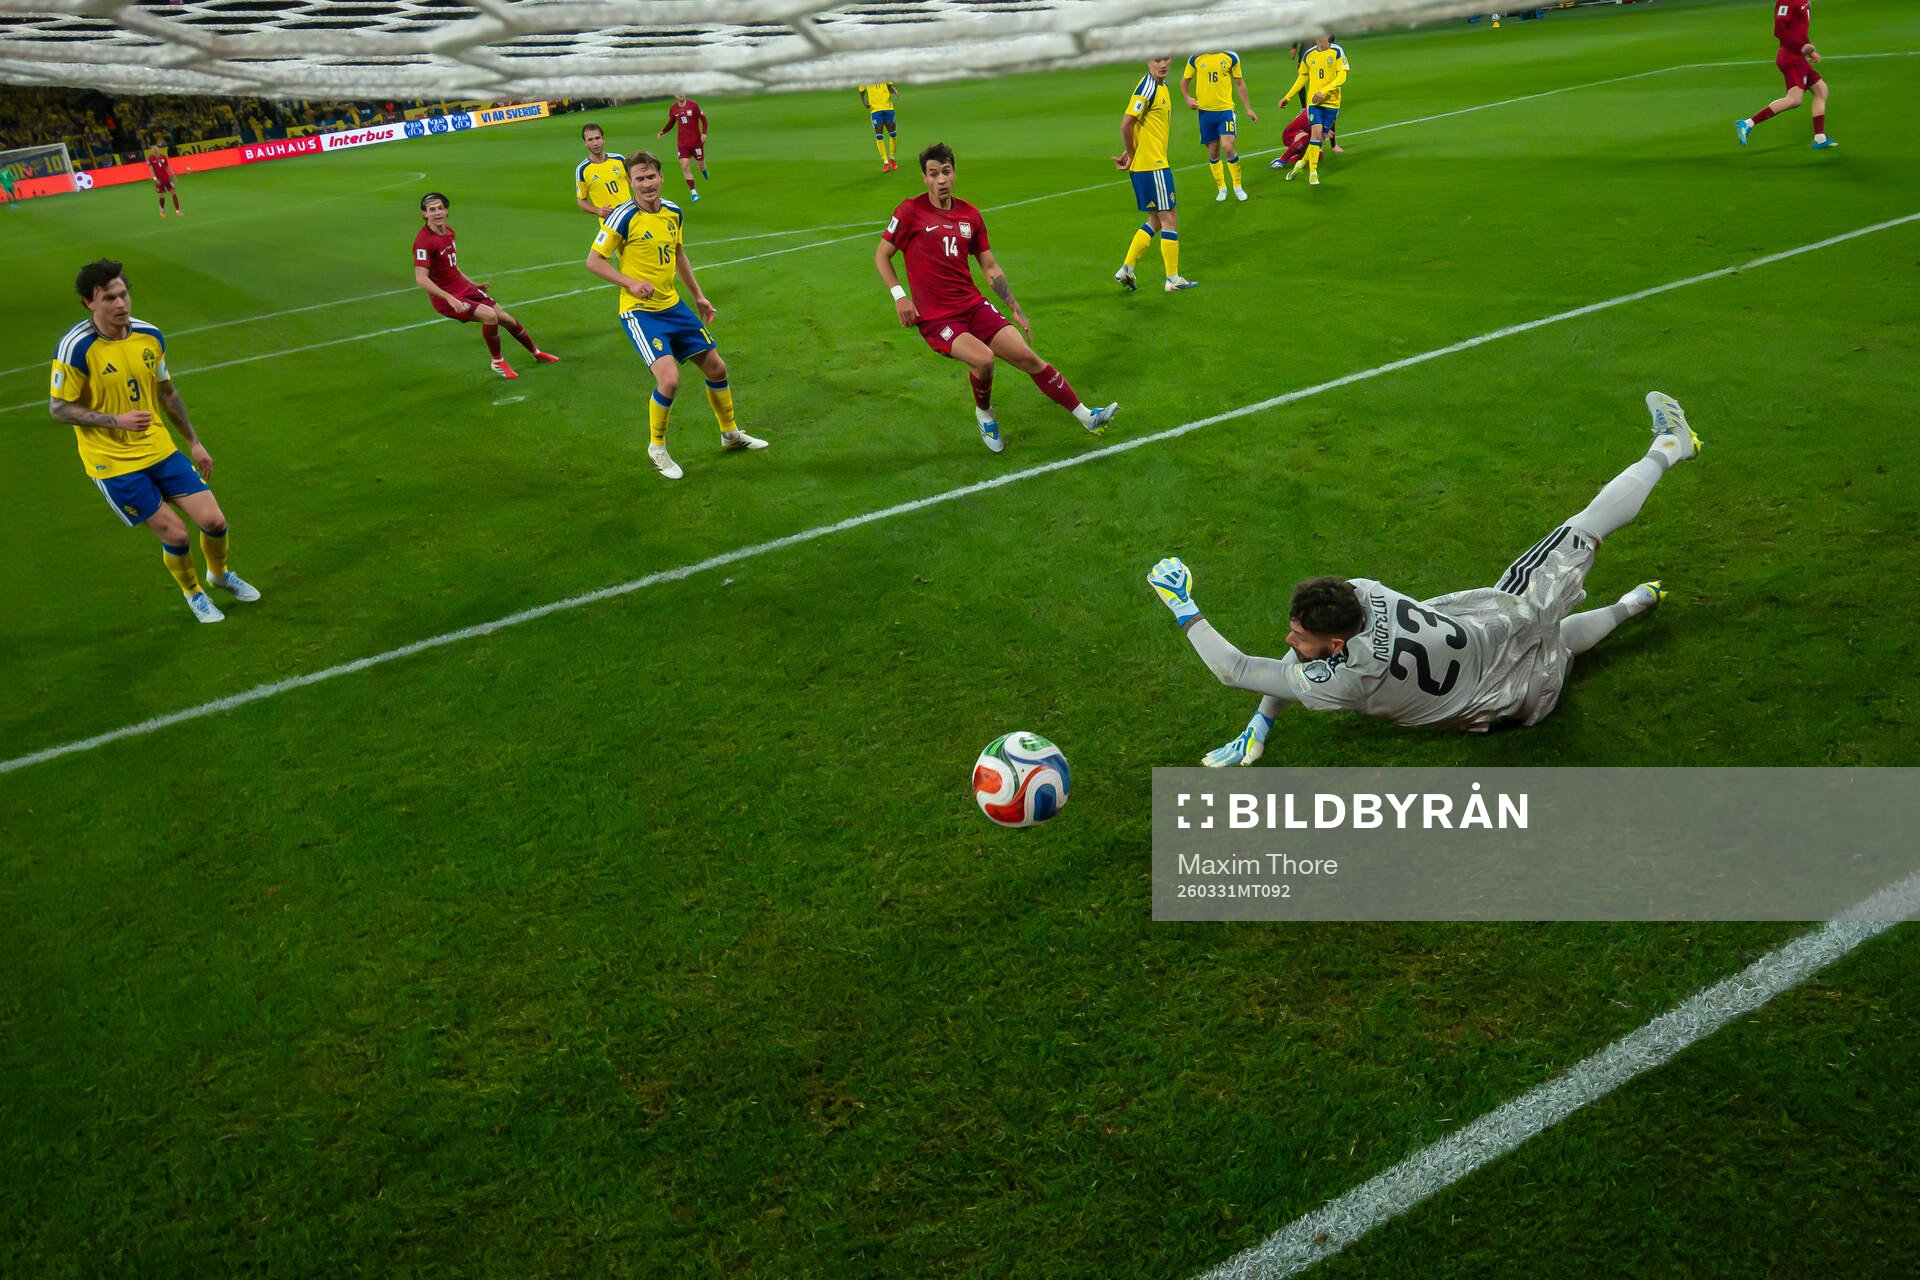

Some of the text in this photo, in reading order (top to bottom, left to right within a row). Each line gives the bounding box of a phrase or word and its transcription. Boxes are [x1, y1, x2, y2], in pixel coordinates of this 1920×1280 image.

[1208, 71, 1218, 83] 16
[481, 111, 492, 123] VI
[505, 104, 542, 119] SVERIGE
[1225, 121, 1235, 132] 16
[328, 128, 394, 147] Interbus
[245, 138, 317, 160] BAUHAUS
[604, 180, 619, 195] 10
[657, 244, 671, 266] 15
[942, 235, 959, 257] 14
[127, 378, 141, 402] 3
[1389, 598, 1468, 697] 23
